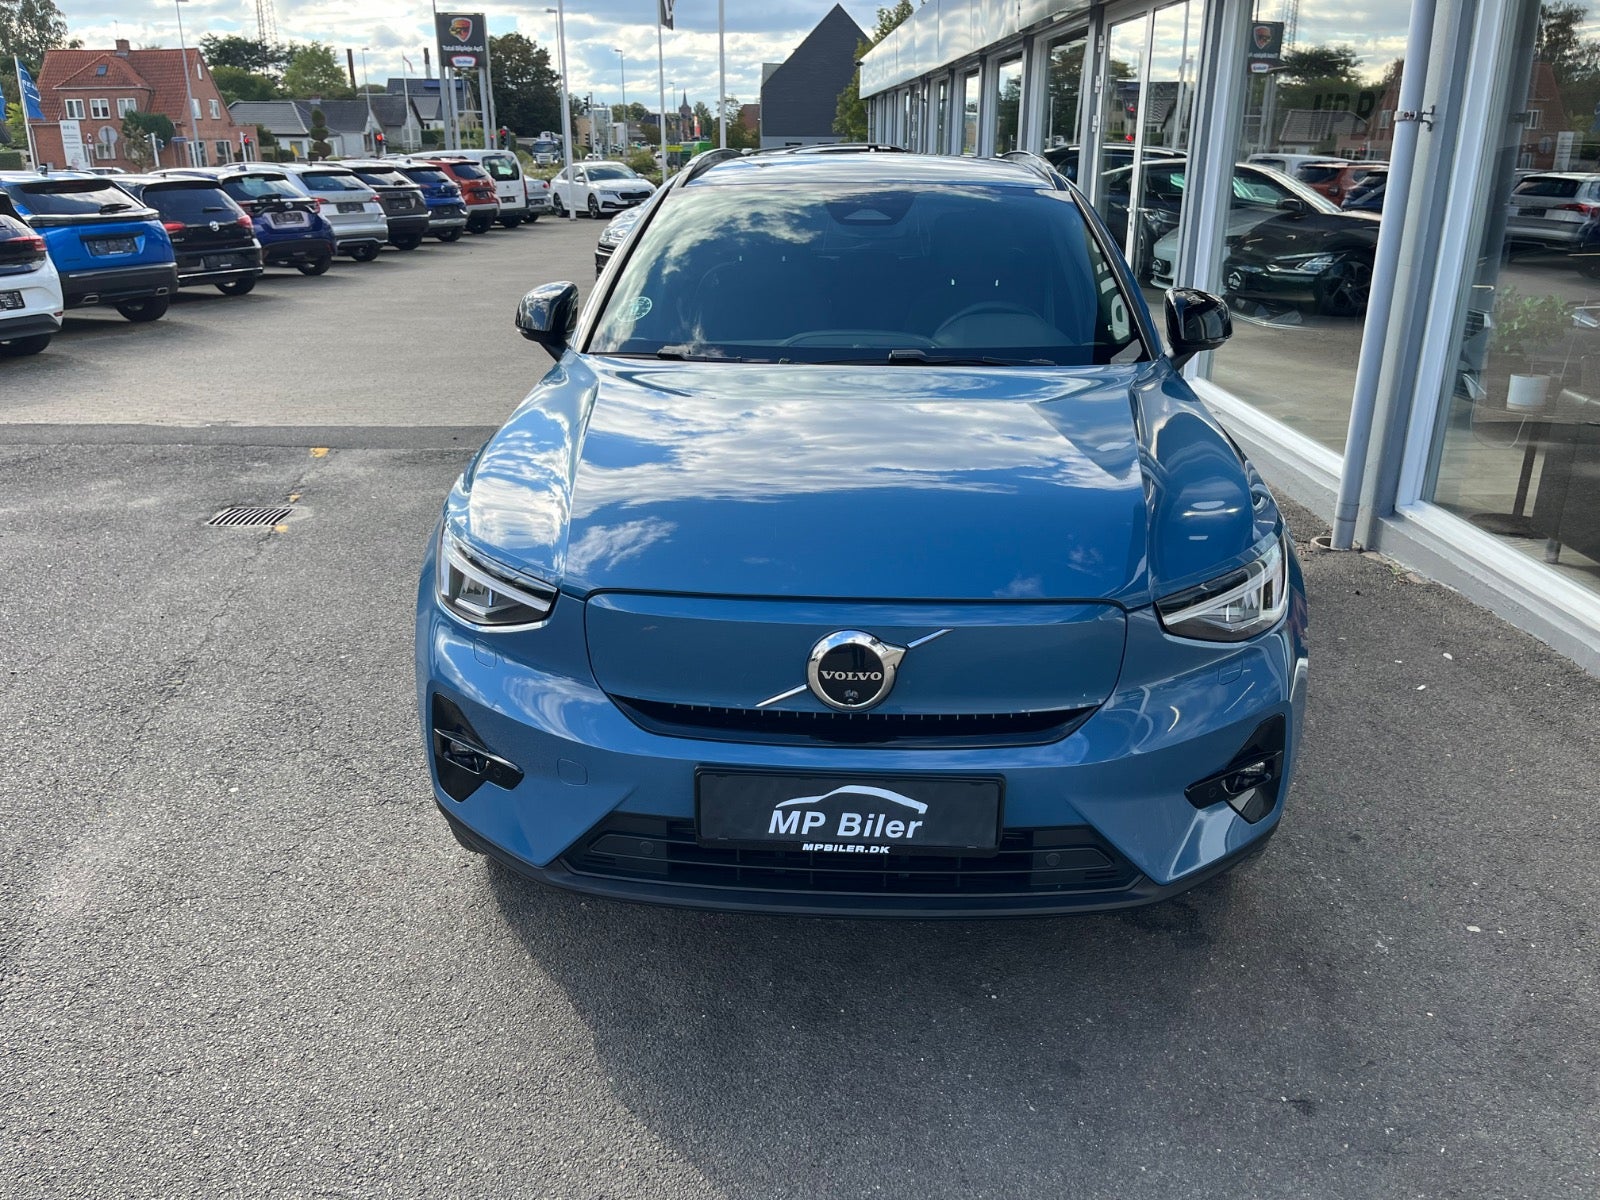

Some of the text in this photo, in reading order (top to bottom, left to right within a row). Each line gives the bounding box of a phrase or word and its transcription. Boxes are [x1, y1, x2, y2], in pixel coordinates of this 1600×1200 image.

[820, 670, 882, 681] VOLVO
[767, 809, 924, 839] MP Biler
[802, 843, 890, 854] MPBILER.DK
